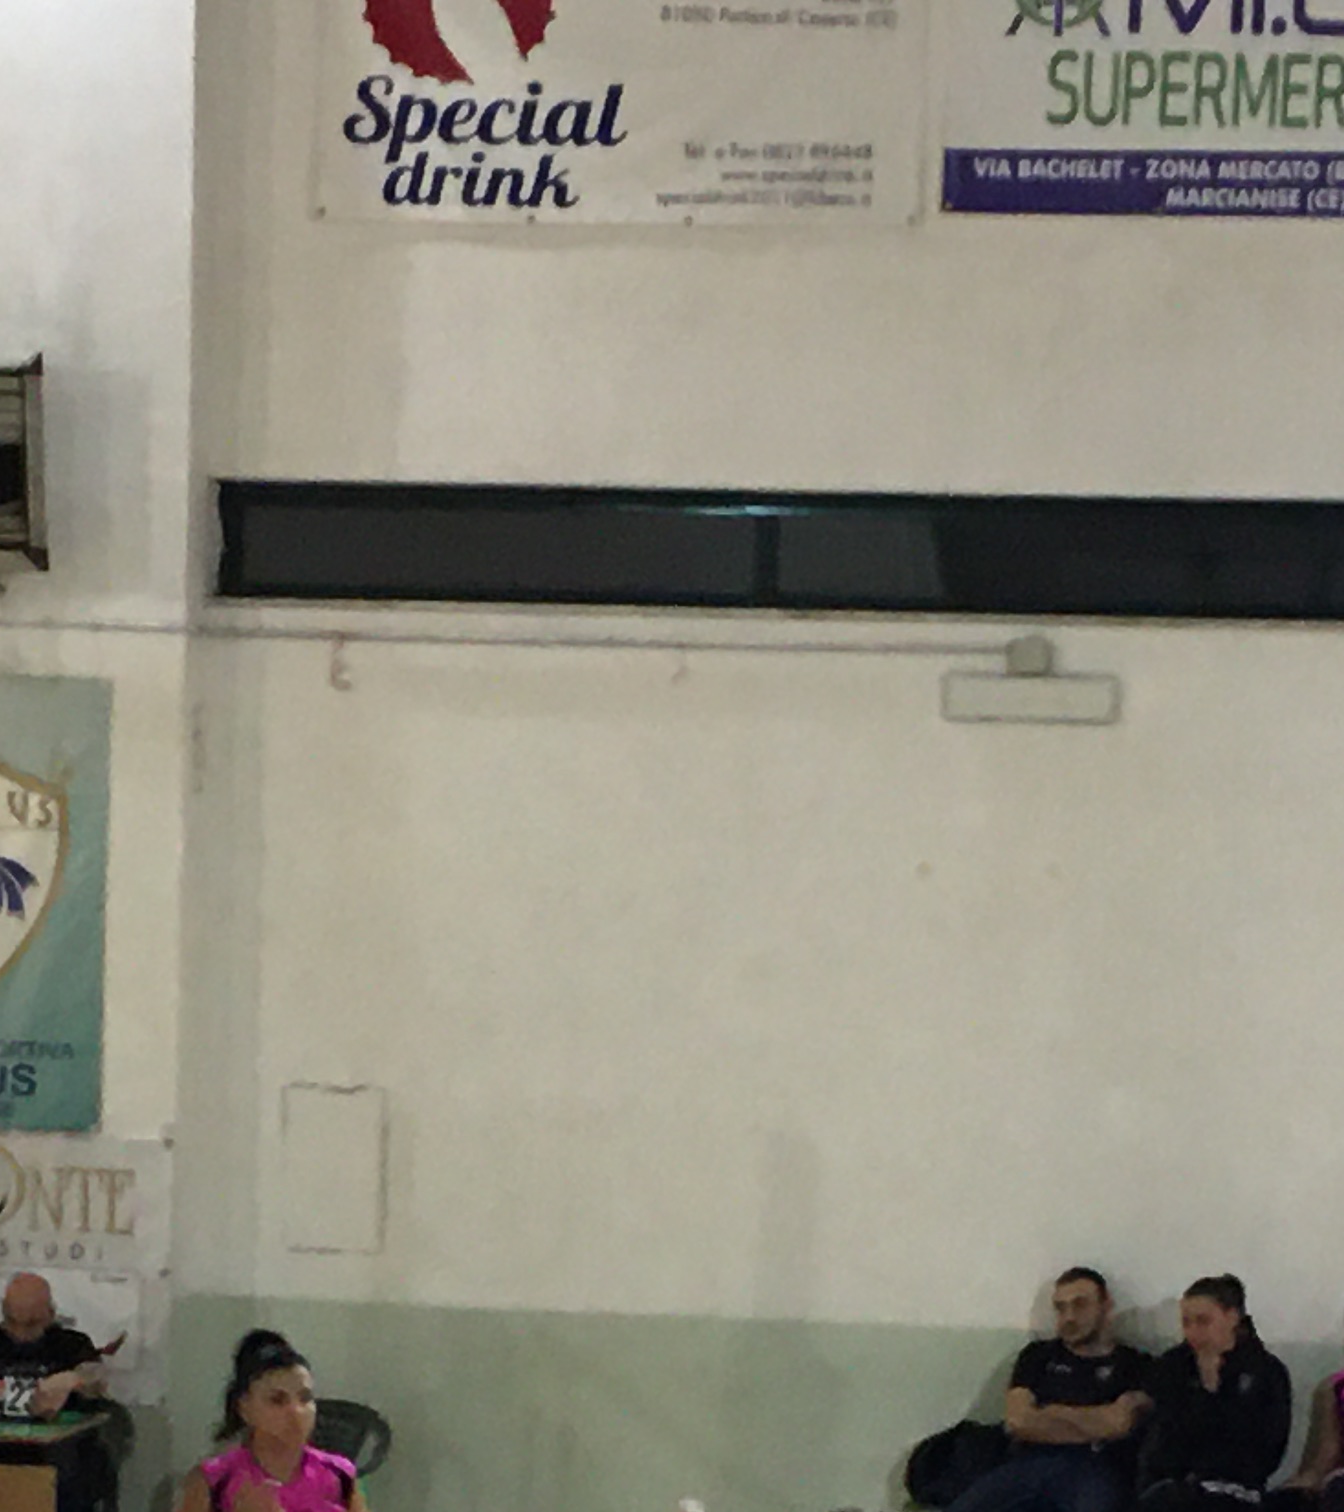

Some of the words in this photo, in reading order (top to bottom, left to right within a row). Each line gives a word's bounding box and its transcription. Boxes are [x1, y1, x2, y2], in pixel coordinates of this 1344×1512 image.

[343, 75, 627, 162] Special
[382, 151, 580, 208] drink
[973, 156, 1011, 179] VIA
[1018, 157, 1124, 180] BACHELET
[1145, 159, 1211, 181] ZONA
[1218, 160, 1319, 181] MERCATO
[1166, 187, 1301, 209] MARCIANISE
